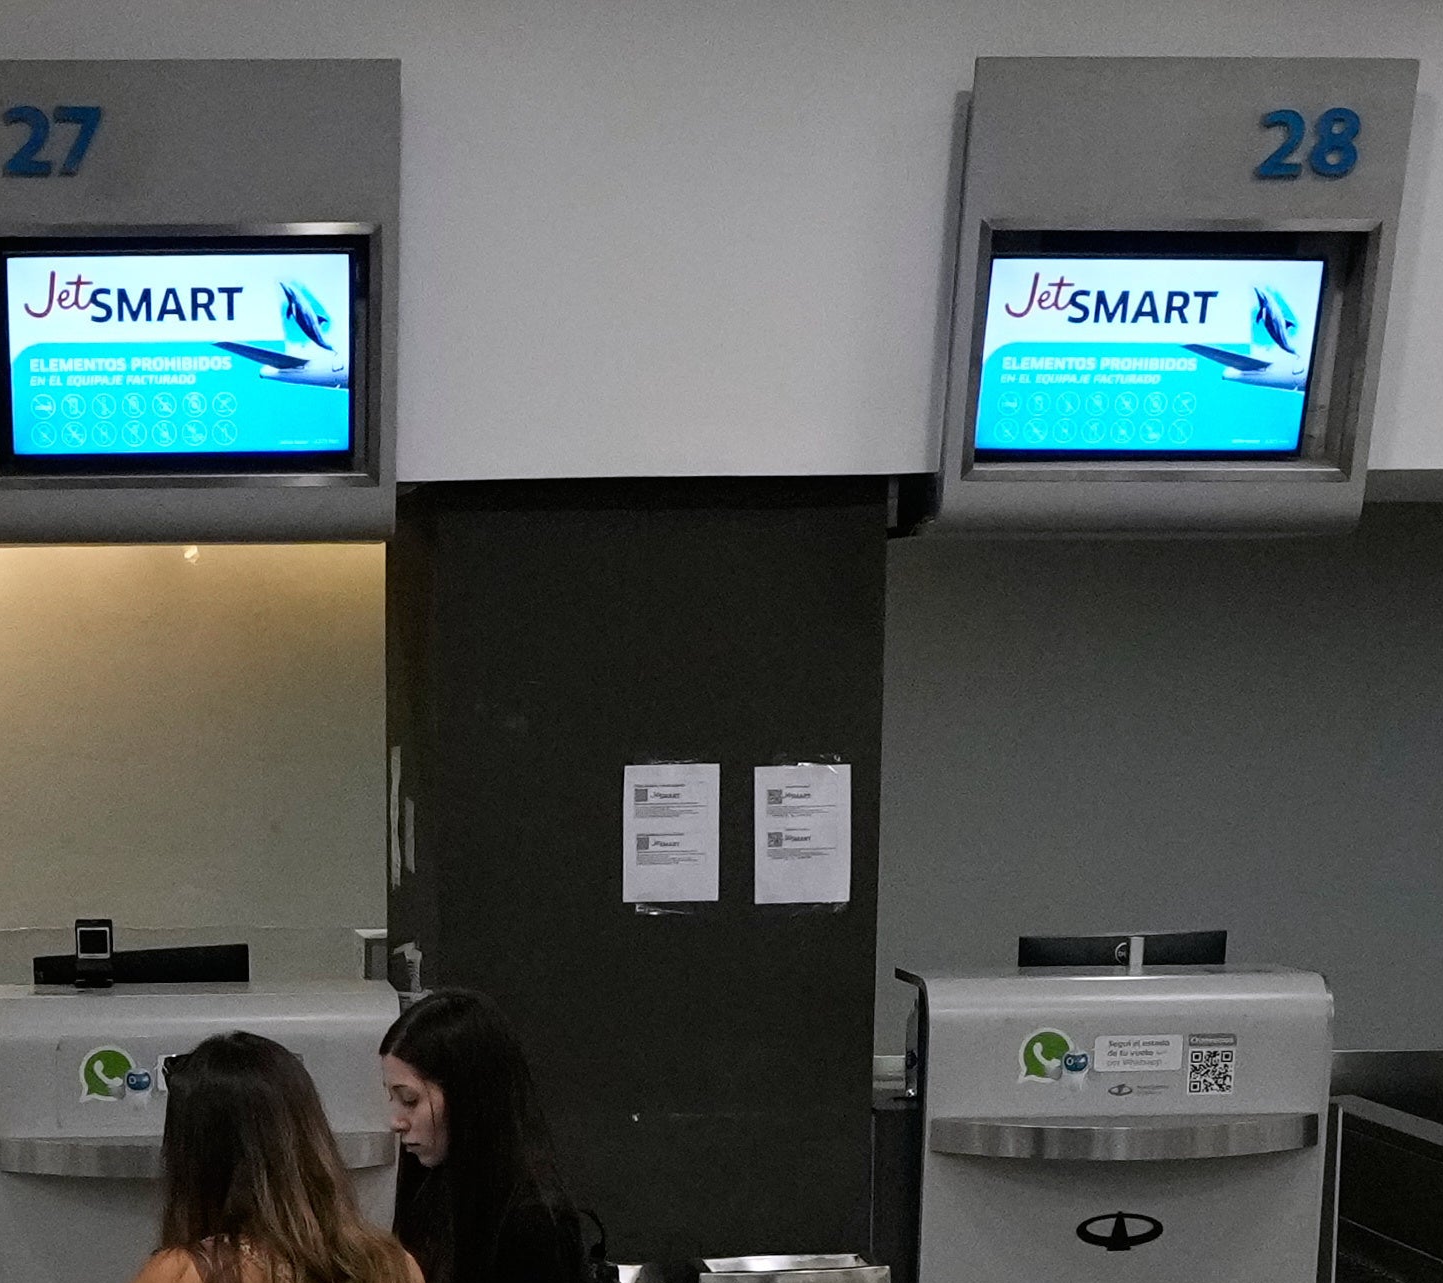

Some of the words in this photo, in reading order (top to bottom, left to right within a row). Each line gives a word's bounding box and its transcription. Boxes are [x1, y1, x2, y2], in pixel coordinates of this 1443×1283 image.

[2, 104, 103, 178] 27
[1255, 107, 1361, 179] 28
[24, 270, 244, 324] JetSMART
[1004, 272, 1219, 325] JetSMART
[29, 356, 127, 373] ELEMENTOS
[131, 355, 232, 372] PROHIBIDOS
[29, 375, 45, 386] EN
[48, 375, 63, 386] EL
[66, 375, 123, 387] EQUIPAJE
[126, 374, 198, 386] FACTURADO
[1001, 374, 1015, 384] EN
[1035, 374, 1091, 386] EQUIPAJE
[1002, 356, 1096, 372] ELEMENTOS
[1100, 356, 1198, 372] PROHIBIDOS
